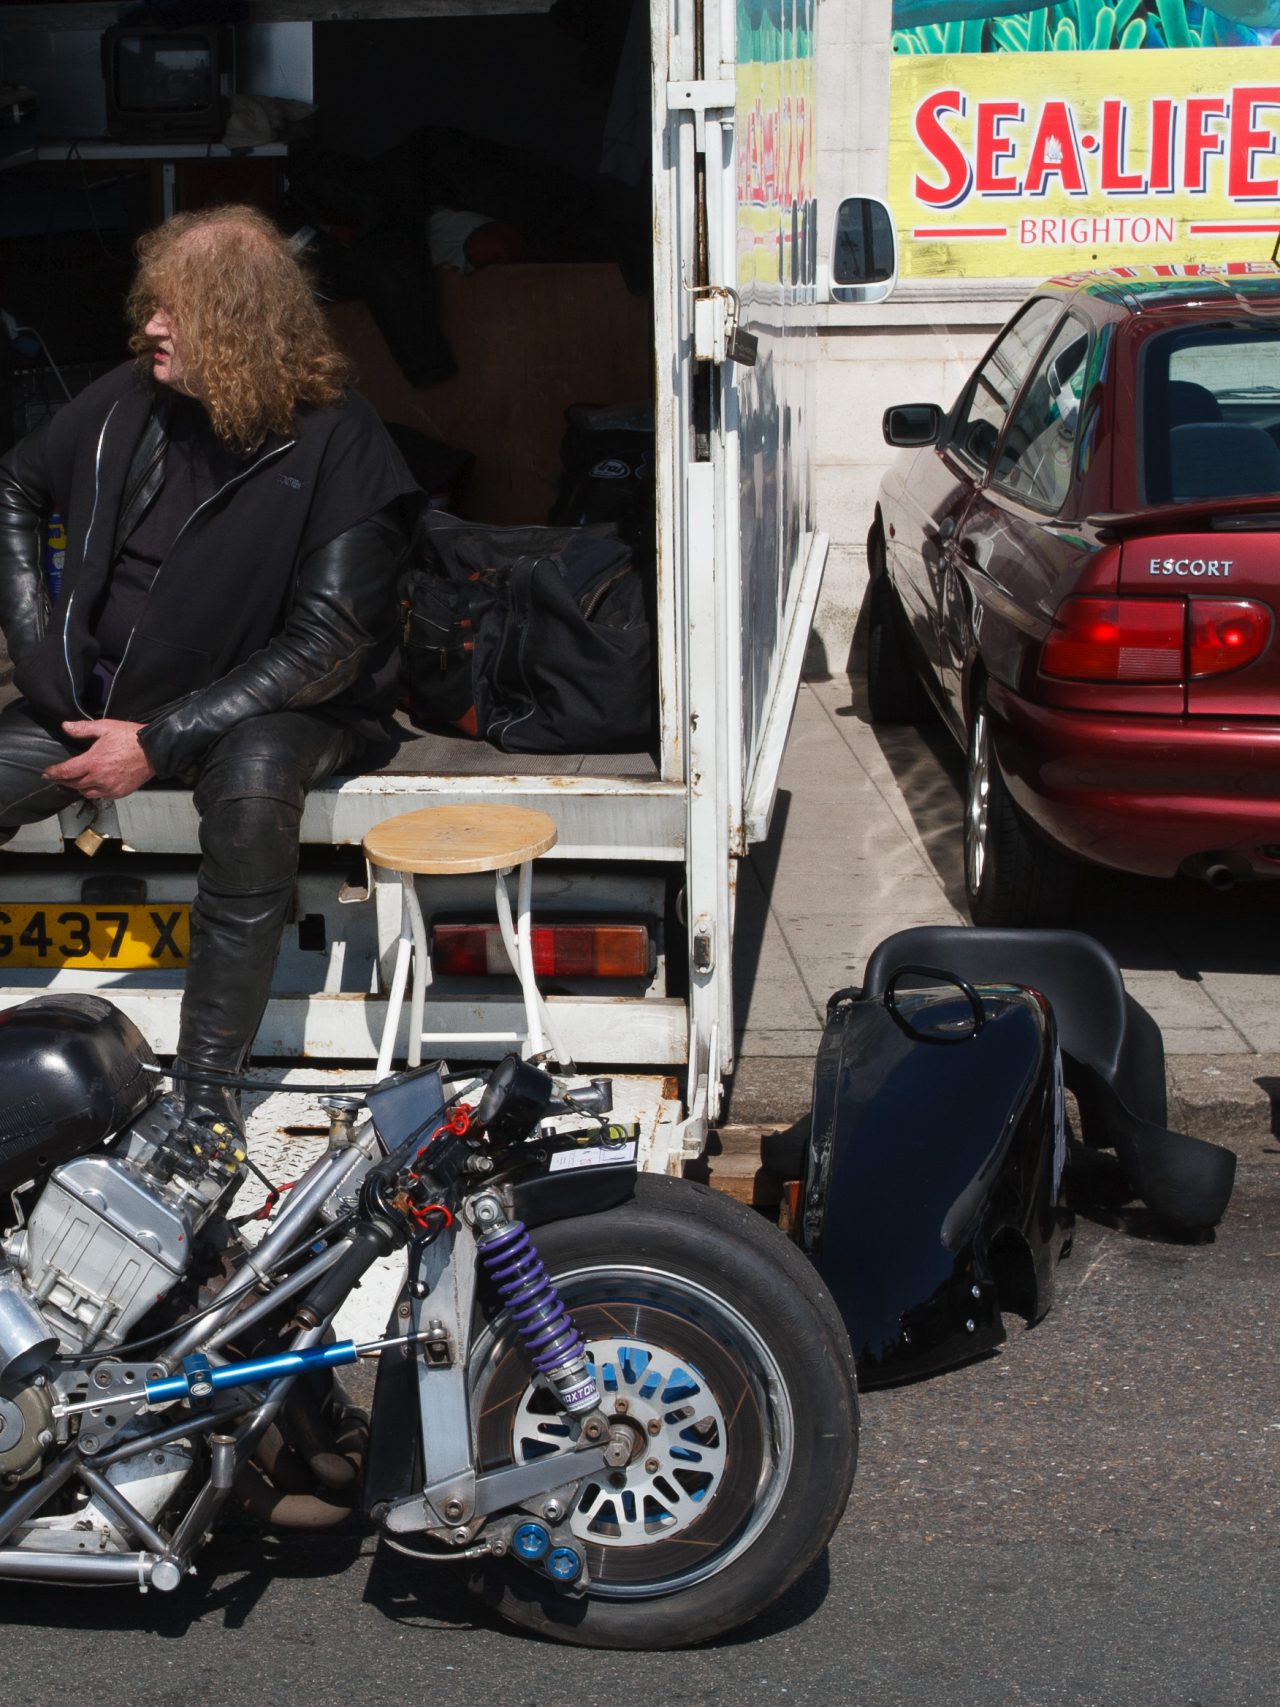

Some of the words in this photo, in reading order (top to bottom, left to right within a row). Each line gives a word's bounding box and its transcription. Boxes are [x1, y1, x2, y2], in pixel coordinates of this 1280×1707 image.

[1020, 217, 1174, 244] BRIGHTON
[1149, 558, 1233, 577] ESCORT
[149, 911, 193, 959] X
